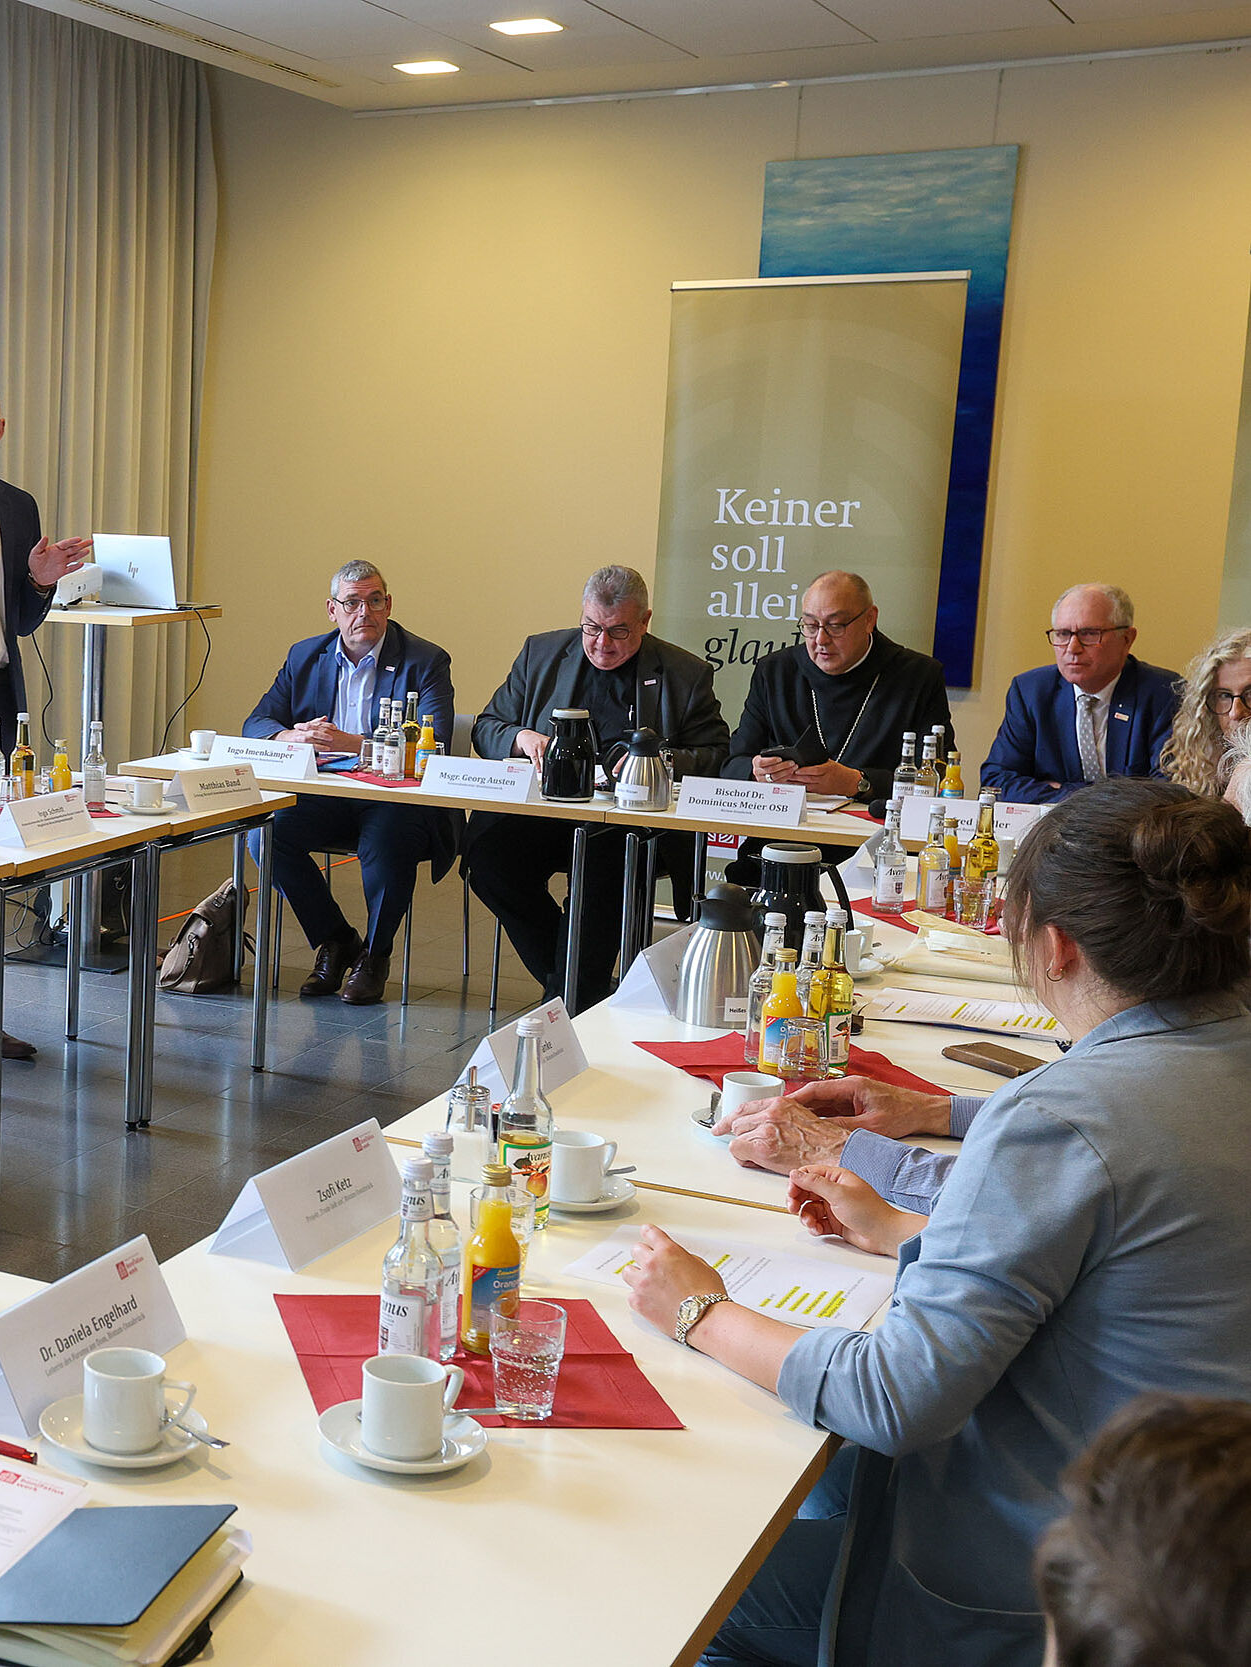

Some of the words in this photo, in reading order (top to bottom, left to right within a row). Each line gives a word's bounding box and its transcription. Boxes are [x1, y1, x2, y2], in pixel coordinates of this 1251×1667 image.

[713, 488, 861, 528] Keiner
[711, 535, 787, 573] soll
[706, 581, 800, 621] allei
[227, 746, 244, 755] Ingo
[245, 749, 294, 760] Imenkämper
[199, 781, 226, 791] Matthias
[439, 771, 460, 781] Msgr.
[461, 774, 486, 784] Georg
[487, 776, 516, 786] Austen
[715, 787, 751, 798] Bischof
[751, 790, 765, 799] Dr.
[688, 796, 737, 808] Dominicus
[739, 801, 767, 811] Meier
[769, 804, 789, 813] OSB
[316, 1183, 337, 1202] Zsofi
[335, 1178, 352, 1193] Ketz
[39, 1346, 56, 1362] Dr.
[54, 1323, 93, 1354] Daniela
[91, 1293, 138, 1331] Engelhard
